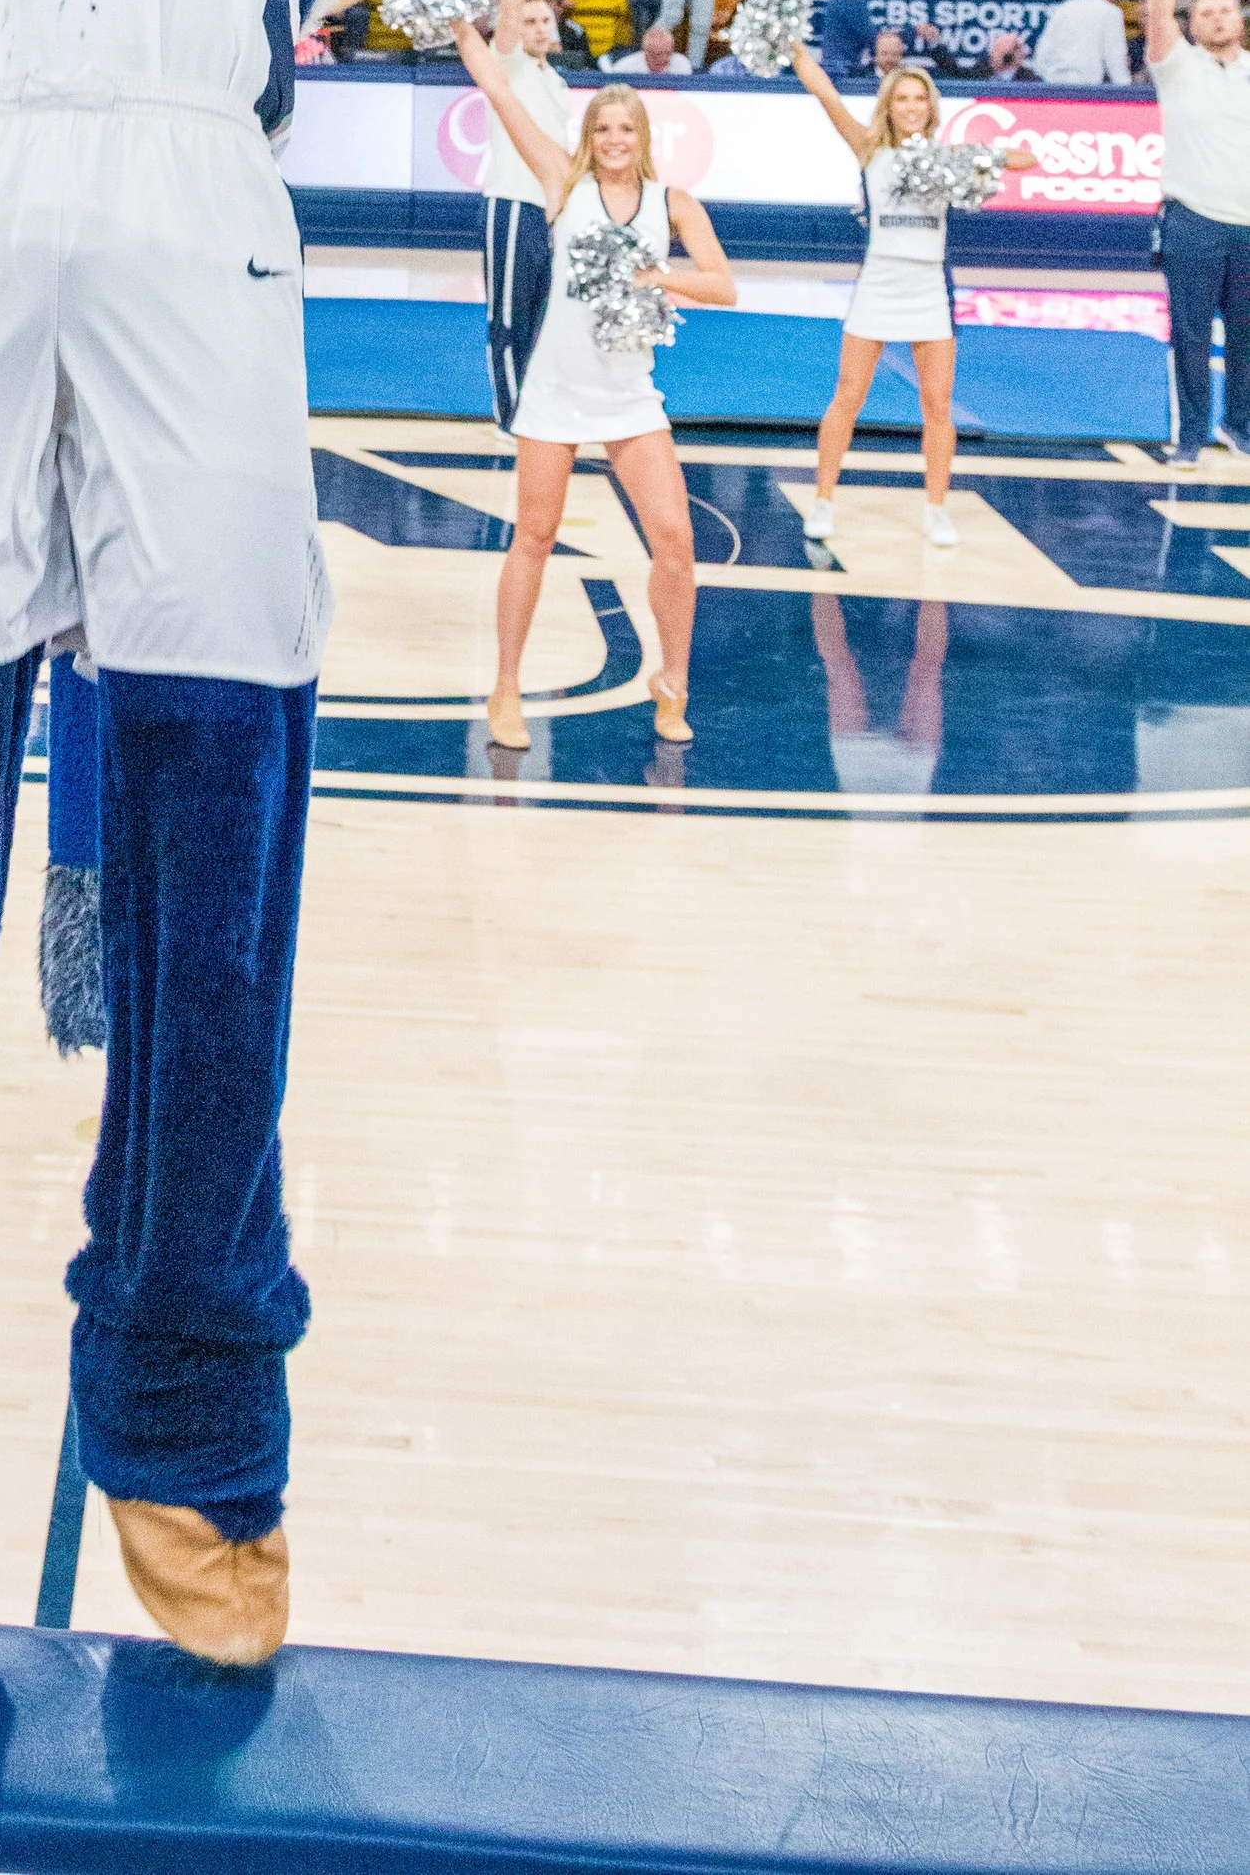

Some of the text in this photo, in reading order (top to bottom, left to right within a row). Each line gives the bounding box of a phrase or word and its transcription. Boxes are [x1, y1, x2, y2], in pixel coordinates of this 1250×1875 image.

[867, 0, 1052, 28] CBS SPORT
[949, 103, 1166, 178] Gossne
